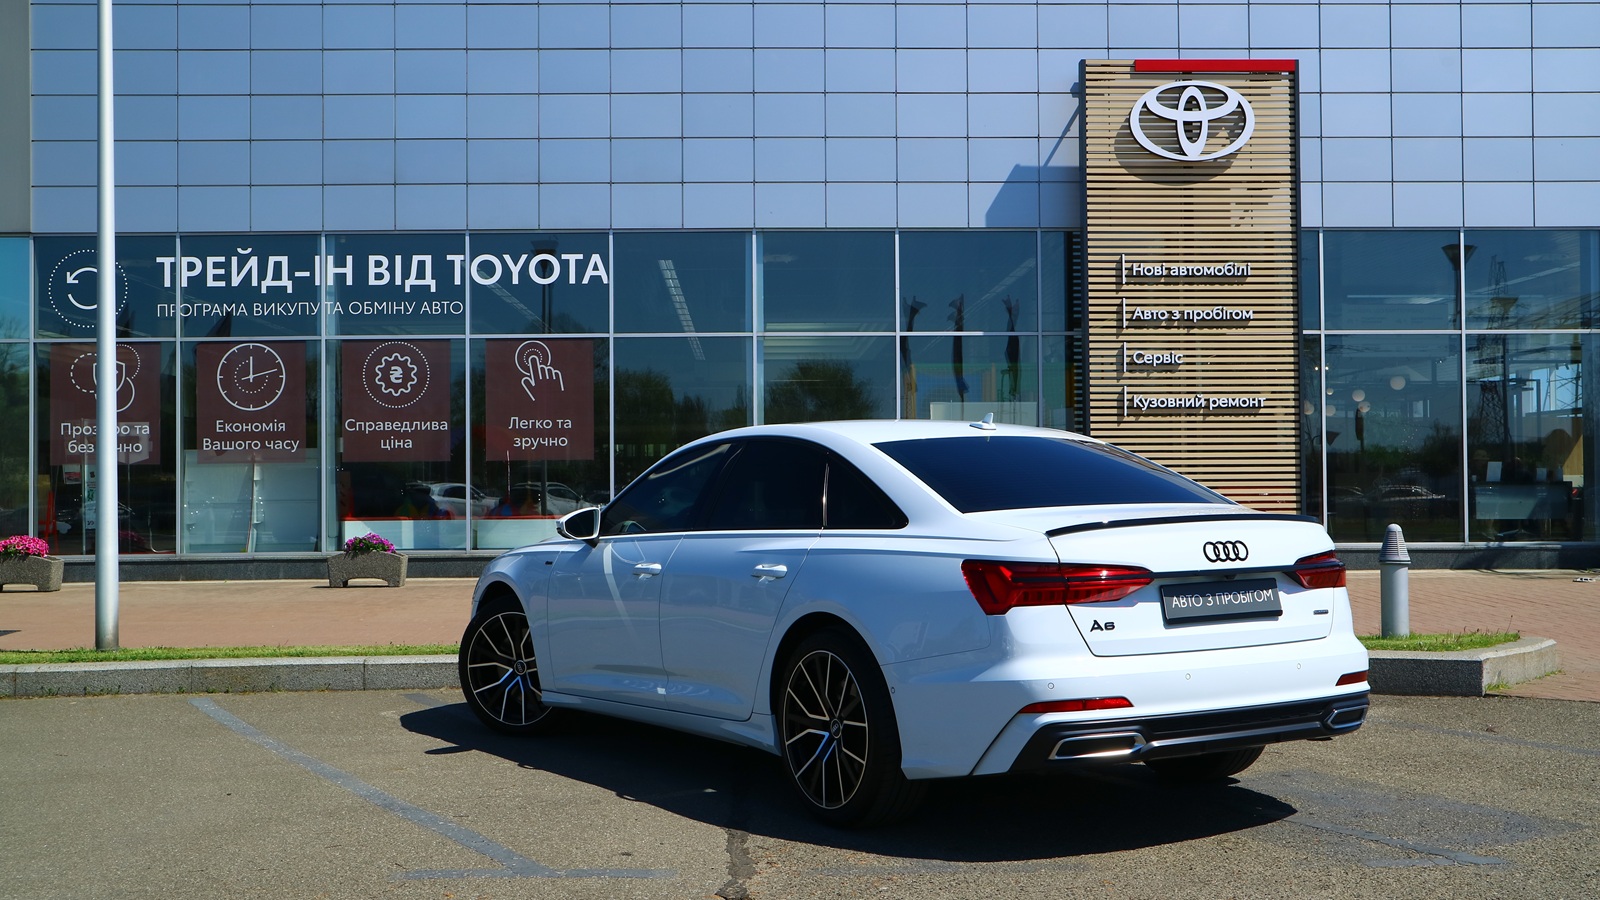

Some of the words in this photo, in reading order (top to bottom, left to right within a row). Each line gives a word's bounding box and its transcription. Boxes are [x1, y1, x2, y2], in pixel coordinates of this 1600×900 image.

[156, 247, 353, 294] ТРЕЙД-ІН
[368, 254, 437, 293] ВІД
[446, 253, 609, 286] TOYOTA
[1133, 263, 1166, 276] Нові
[1170, 262, 1251, 276] автомобілі
[157, 302, 248, 318] ПРОГРАМА
[253, 302, 321, 317] ВИКУПУ
[324, 301, 344, 316] ТА
[348, 301, 416, 316] ОБМІНУ
[420, 300, 464, 315] АВТО
[1133, 307, 1168, 320] Авто
[1171, 309, 1180, 320] з
[1184, 306, 1254, 323] пробігом
[1133, 351, 1184, 367] Сервіс
[1133, 394, 1206, 411] Кузовний
[1209, 397, 1267, 411] ремонт
[61, 422, 131, 438] Прозо
[134, 425, 150, 435] та
[215, 419, 286, 433] Економія
[345, 418, 448, 434] Справедлива
[508, 416, 552, 430] Легко
[556, 418, 573, 429] та
[68, 440, 143, 454] безчно
[203, 437, 261, 450] Вашого
[265, 440, 300, 453] часу
[380, 436, 413, 450] ціна
[513, 437, 568, 450] зручно
[1172, 594, 1203, 609] АВТО
[1215, 589, 1275, 606] ПРОБІГОМ
[1090, 619, 1116, 633] A6
